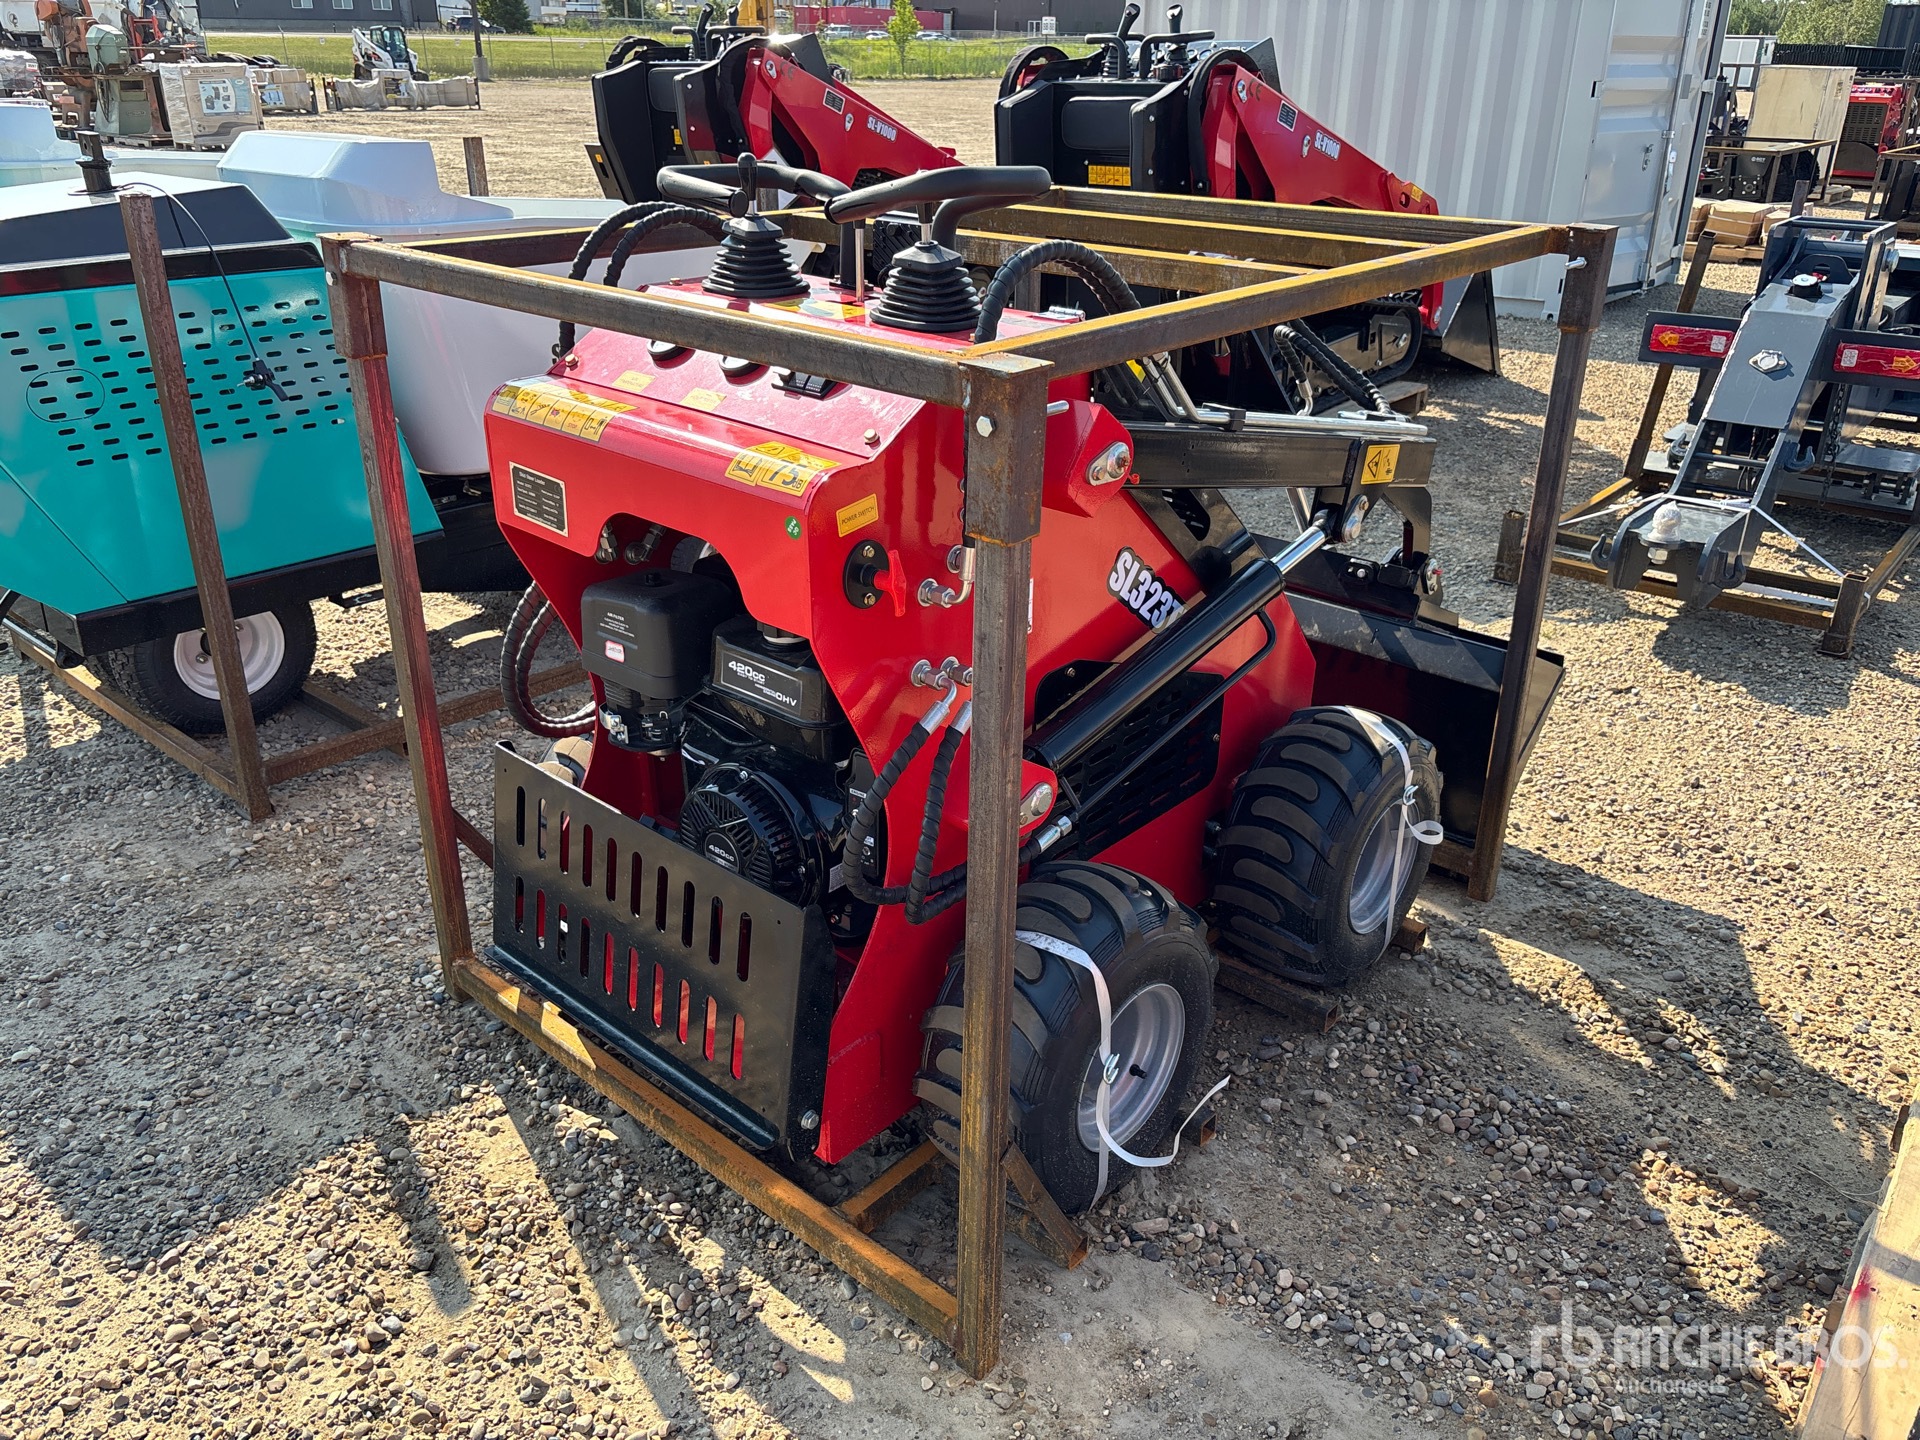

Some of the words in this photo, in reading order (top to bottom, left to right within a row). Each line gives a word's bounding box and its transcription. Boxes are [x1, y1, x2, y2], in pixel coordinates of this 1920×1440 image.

[867, 115, 897, 142] SL-V1000
[1314, 131, 1341, 159] SL-V1000
[841, 513, 858, 525] POWER
[857, 506, 875, 518] SWITCH
[787, 518, 797, 533] PASS
[728, 660, 766, 682] 420cc
[775, 692, 798, 707] OHV
[708, 844, 735, 862] 420cc
